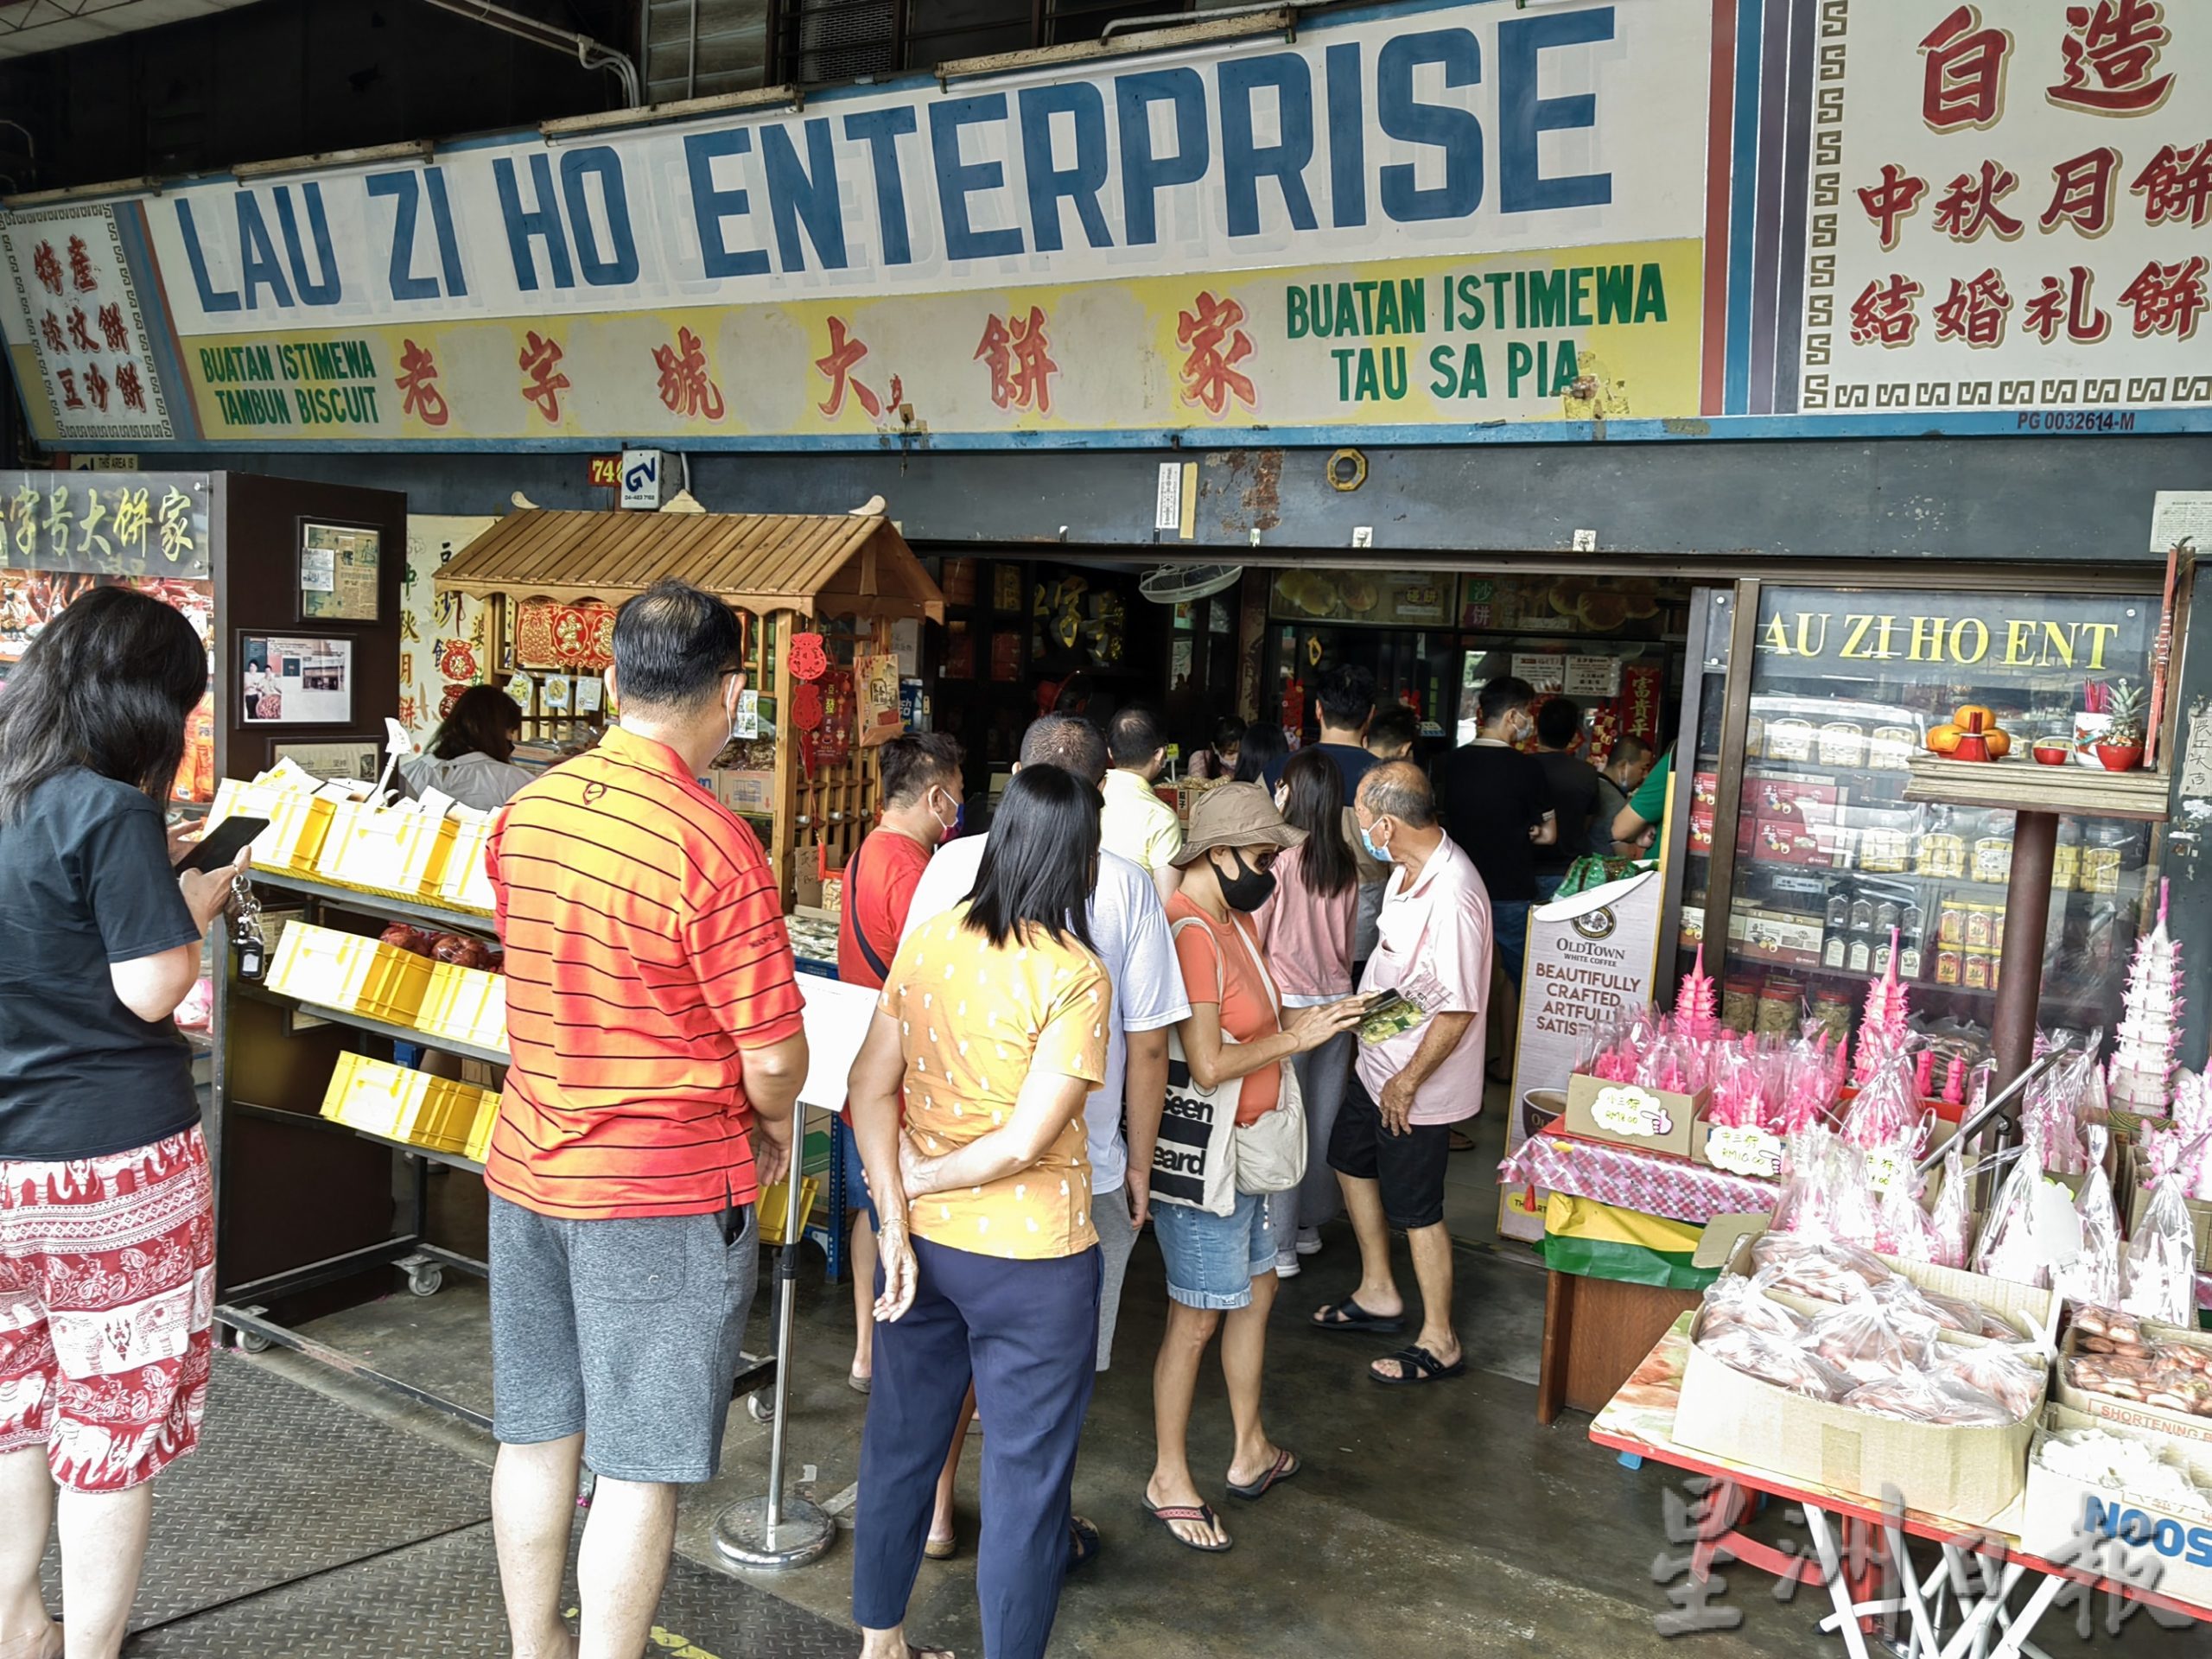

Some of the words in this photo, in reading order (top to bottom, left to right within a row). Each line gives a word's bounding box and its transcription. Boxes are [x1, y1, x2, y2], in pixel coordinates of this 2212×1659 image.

[175, 181, 342, 313] LAU
[366, 166, 468, 302] ZI
[493, 144, 639, 291] HO
[683, 6, 1615, 279] ENTERPRISE
[1856, 139, 2212, 249] 中秋月餅
[1287, 278, 1426, 340] BUATAN
[1444, 263, 1668, 333] ISTIMEWA
[200, 346, 274, 384] BUATAN
[278, 340, 377, 381] ISTIMEWA
[1332, 346, 1408, 403] TAU
[1430, 343, 1487, 399] SA
[1508, 340, 1581, 399] PIA
[56, 360, 146, 413] 豆沙餅
[215, 388, 290, 425] TAMBUN
[297, 386, 379, 424] BISCUIT
[2017, 413, 2040, 431] PG
[2045, 411, 2136, 431] 0032614-M
[111, 457, 126, 468] AREA
[1840, 614, 1897, 659] ZI
[1905, 616, 1989, 664] HO
[2000, 620, 2118, 670] ENT
[1535, 963, 1641, 993] BEAUTIFULLY
[1564, 953, 1588, 963] WHITE
[1590, 956, 1617, 967] COFFEE
[1547, 983, 1621, 1007] CRAFTED
[2101, 1405, 2199, 1439] SHORTENING
